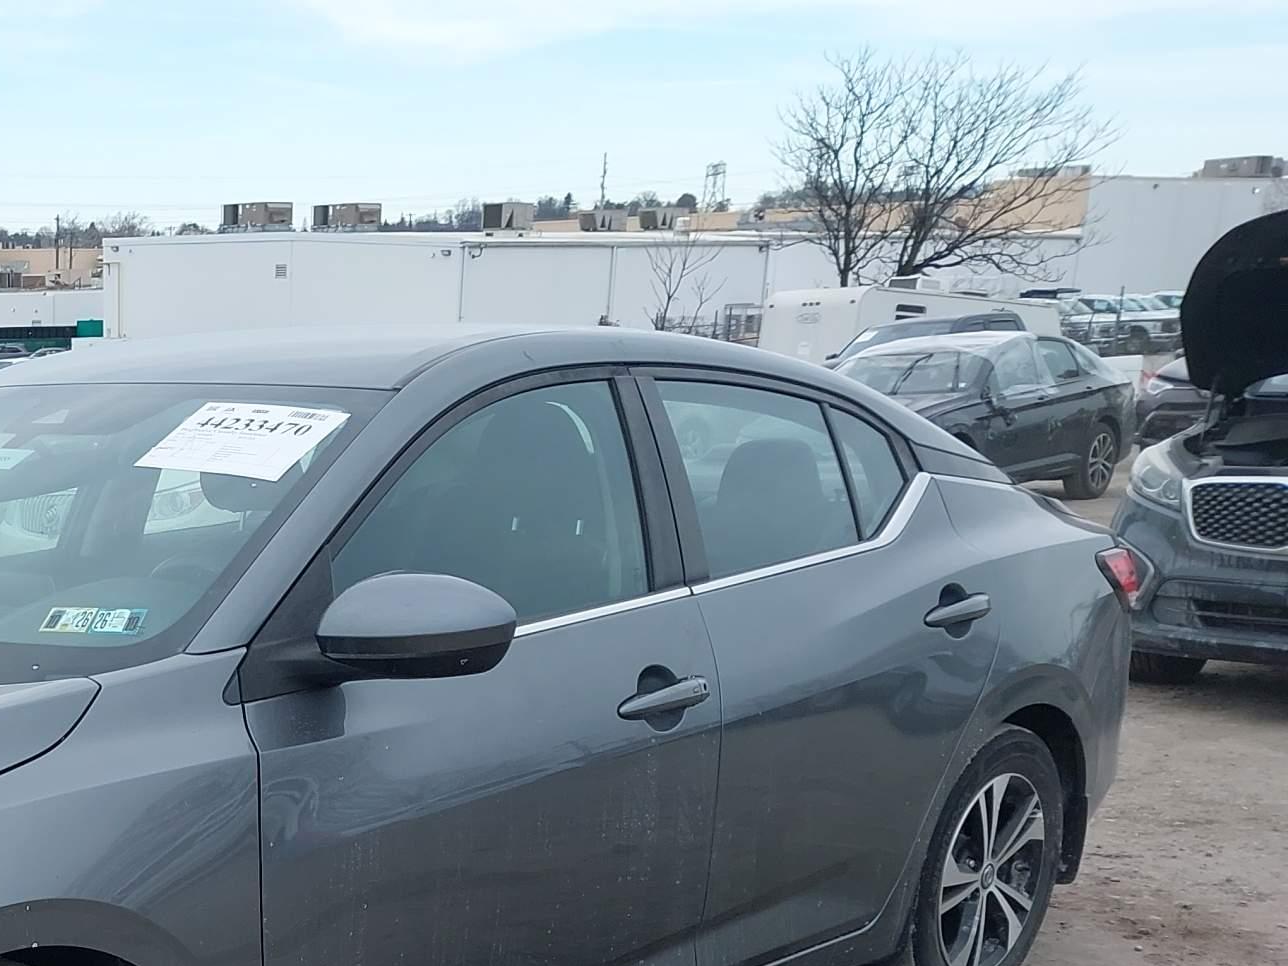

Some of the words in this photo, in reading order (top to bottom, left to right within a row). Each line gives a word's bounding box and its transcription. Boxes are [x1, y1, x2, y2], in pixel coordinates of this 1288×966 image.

[196, 416, 313, 436] 44233470
[75, 611, 93, 628] 26
[95, 612, 111, 630] 26
